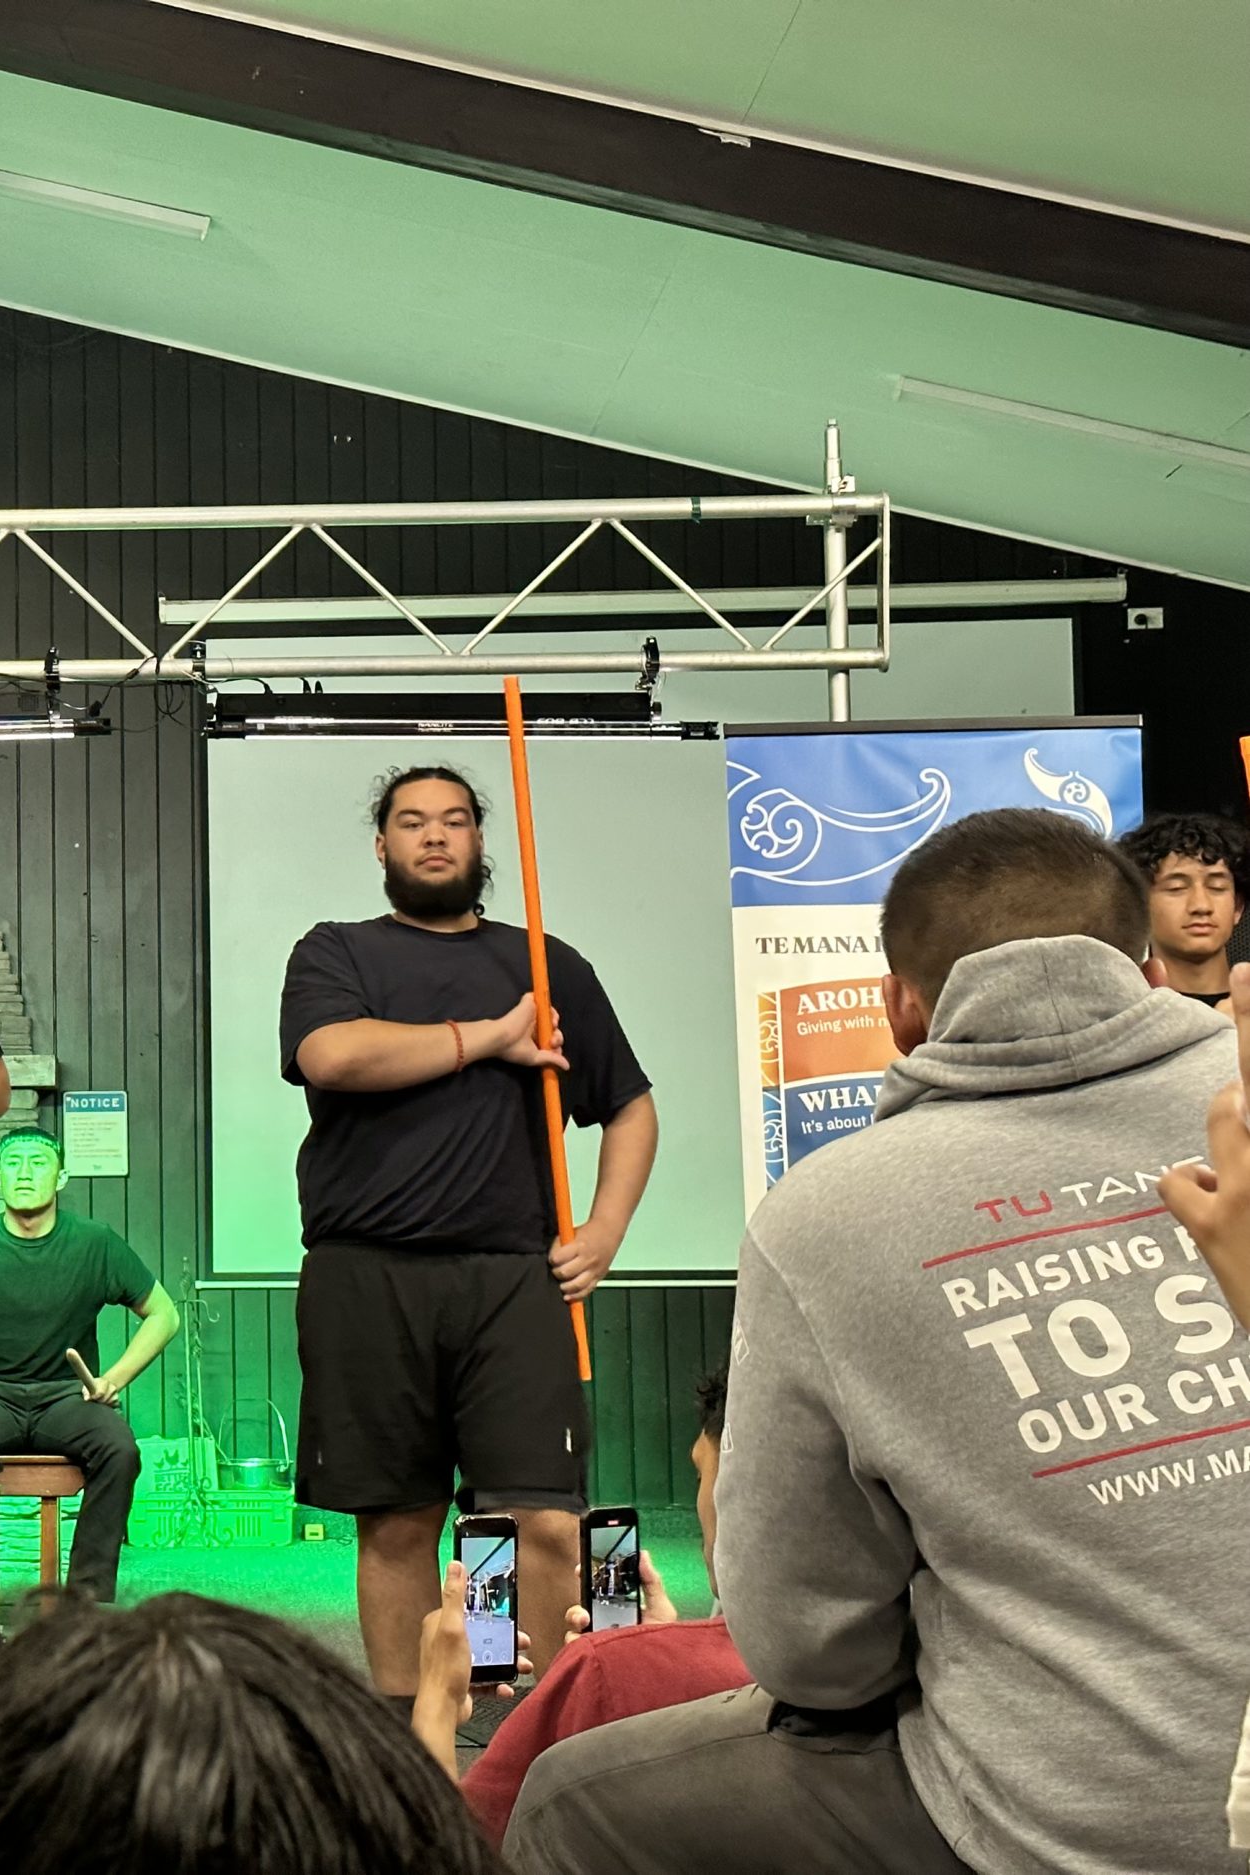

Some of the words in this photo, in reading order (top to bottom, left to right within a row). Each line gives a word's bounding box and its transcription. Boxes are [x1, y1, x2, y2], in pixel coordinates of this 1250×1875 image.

[756, 937, 788, 954] TE
[793, 936, 870, 954] MANA
[797, 986, 885, 1016] AROH
[797, 1020, 842, 1036] Giving
[844, 1015, 875, 1029] with
[70, 1097, 120, 1108] NOTICE
[801, 1117, 824, 1134] It's
[826, 1115, 866, 1131] about
[974, 1190, 1054, 1223] TU
[941, 1235, 1165, 1318] RAISING
[962, 1299, 1132, 1399] TO
[1154, 1274, 1250, 1355] S
[1017, 1383, 1160, 1454] OUR
[1167, 1357, 1250, 1415] CH
